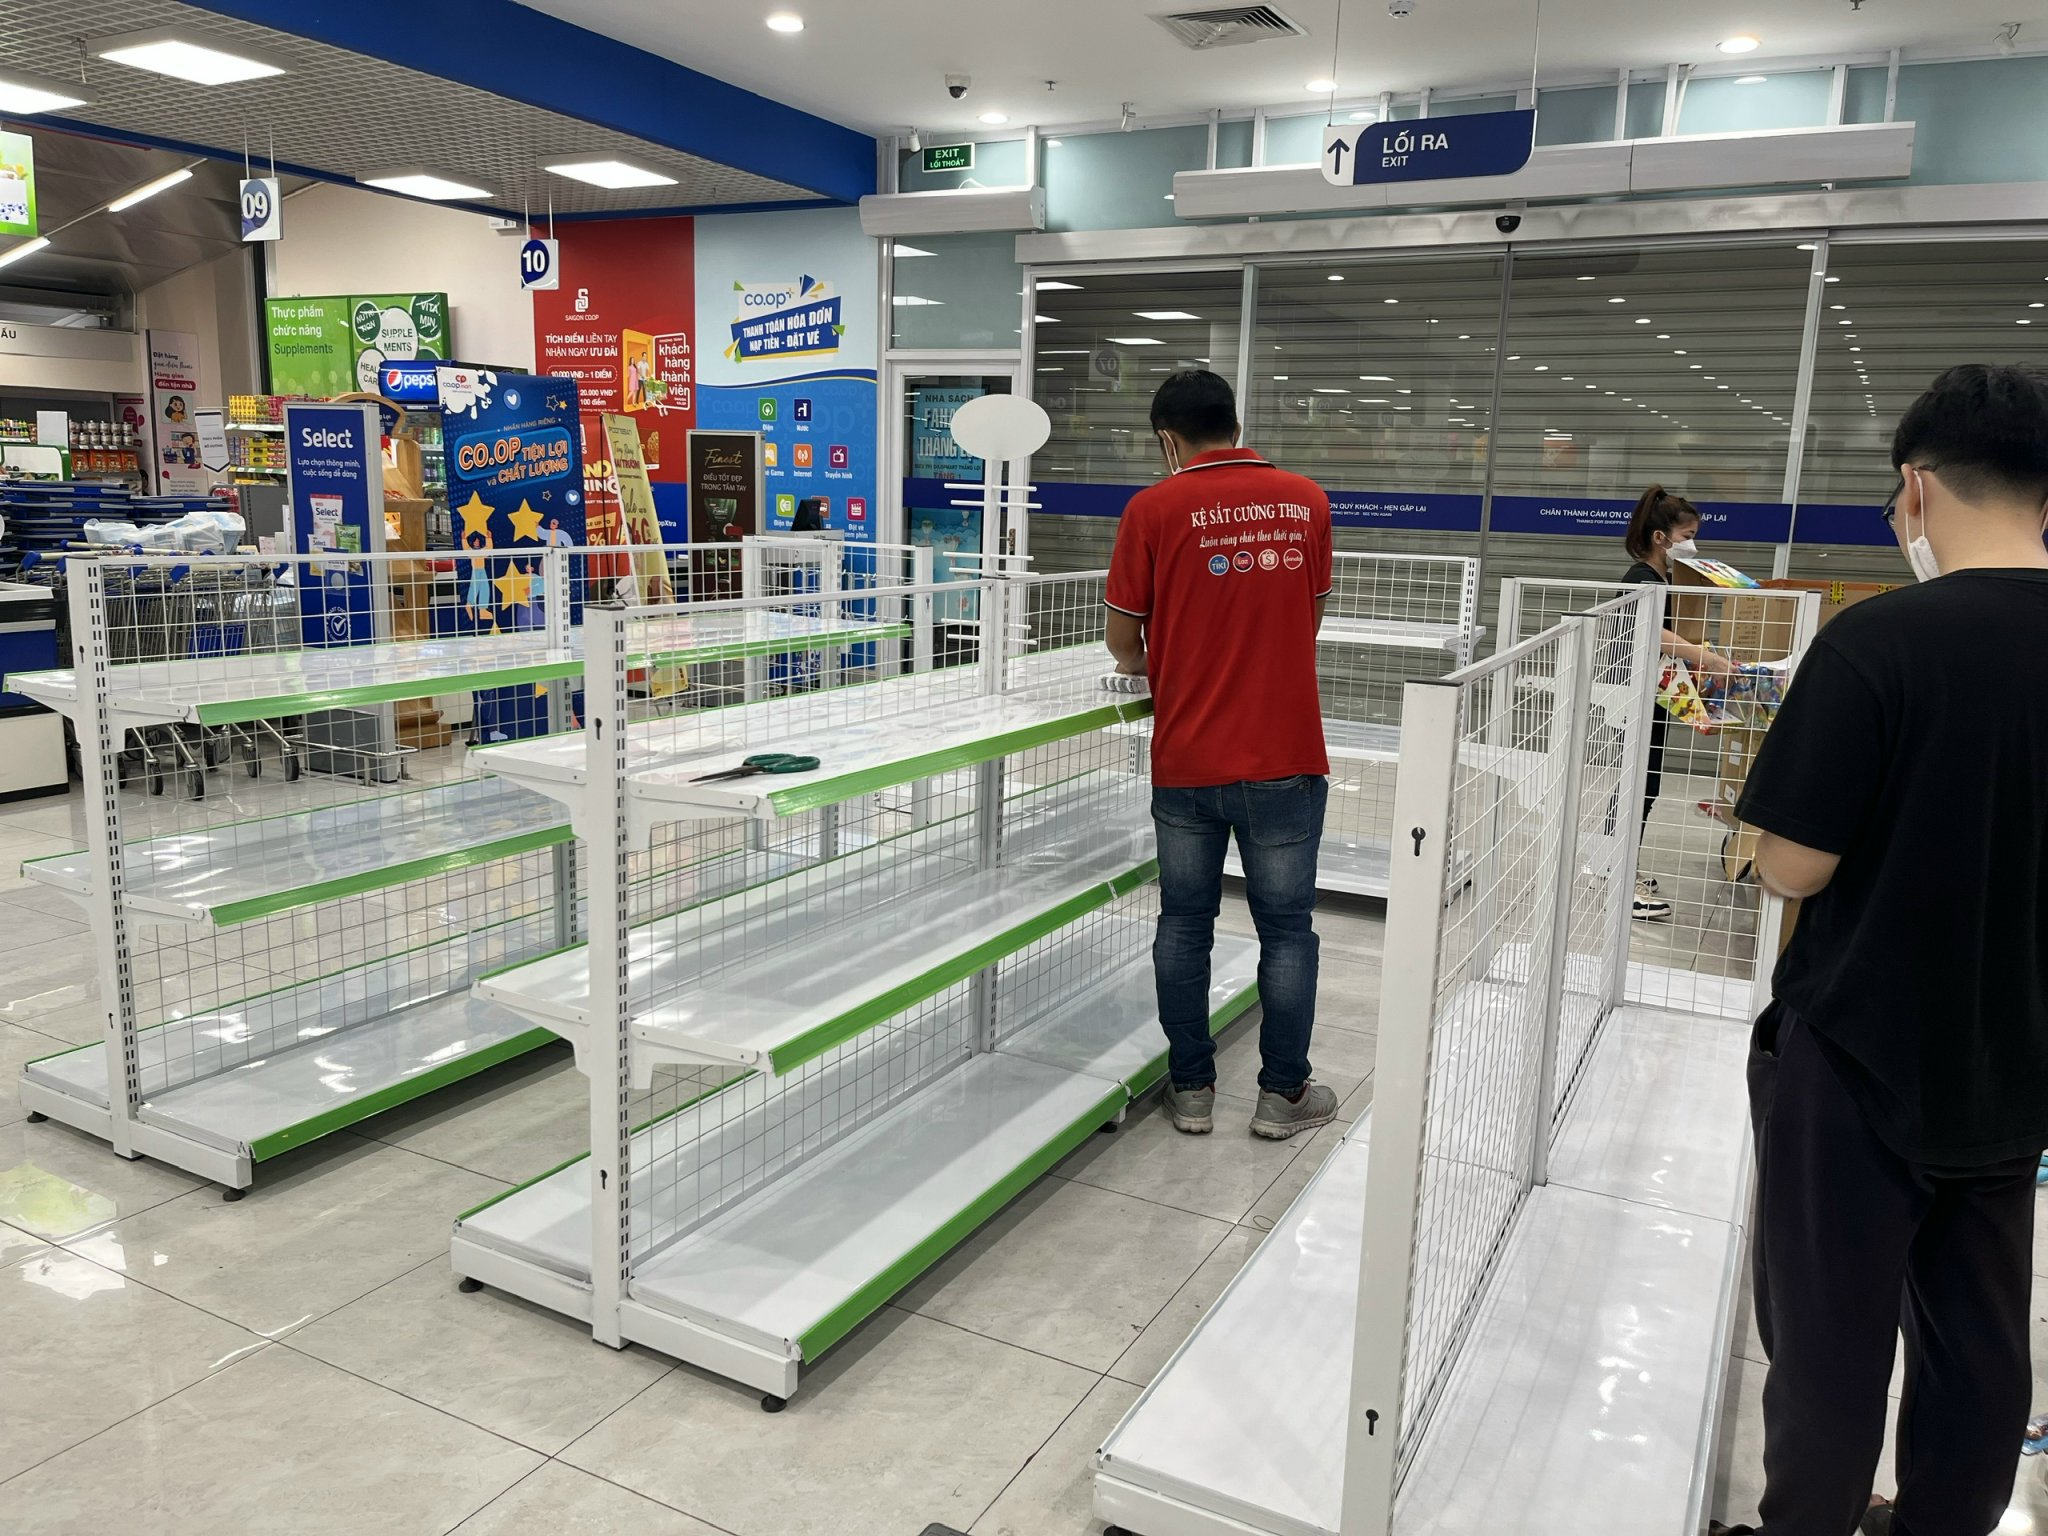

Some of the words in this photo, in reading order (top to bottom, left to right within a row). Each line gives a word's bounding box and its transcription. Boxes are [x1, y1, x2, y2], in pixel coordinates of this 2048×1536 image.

[1382, 129, 1415, 154] LỐI
[1421, 133, 1449, 151] RA
[935, 148, 960, 159] EXIT
[930, 158, 941, 168] LỐI
[942, 157, 965, 168] THOÁT
[1382, 155, 1409, 168] EXIT
[242, 191, 268, 219] 09
[522, 249, 546, 272] 10
[744, 292, 786, 308] co.op
[272, 306, 295, 321] Thực
[298, 304, 324, 320] phẩm
[743, 323, 764, 338] THANH
[765, 317, 785, 335] TOÁN
[787, 313, 806, 331] HÓA
[809, 307, 833, 326] ĐƠN
[273, 325, 297, 336] chức
[299, 326, 322, 338] năng
[381, 328, 413, 339] SUPPLE
[545, 333, 563, 343] TÍCH
[604, 335, 618, 343] TAY
[383, 342, 412, 352] MENTS
[749, 340, 763, 352] NẠP
[764, 335, 779, 350] TIỀN
[787, 333, 805, 349] ĐẶT
[274, 343, 333, 357] Supplements
[546, 346, 566, 358] NHẬN
[568, 347, 588, 357] NGAY
[590, 347, 602, 357] ƯU
[604, 345, 618, 357] ĐÃI
[659, 343, 690, 356] khách
[665, 357, 690, 370] hàng
[661, 371, 690, 383] thành
[669, 384, 690, 396] viên
[302, 428, 353, 448] Select
[459, 437, 520, 470] CO.OP
[704, 448, 742, 466] Finest
[297, 458, 309, 467] Lựa
[311, 458, 325, 467] chọn
[326, 459, 343, 468] thông
[303, 469, 317, 477] cuộc
[318, 469, 332, 478] sống
[316, 508, 338, 516] Select
[1339, 502, 1354, 510] QUÝ
[1354, 502, 1378, 510] KHÁCH
[1400, 504, 1414, 512] GẶP
[1563, 509, 1588, 517] THÀNH
[1190, 507, 1207, 530] KỆ
[1209, 501, 1232, 525] SẮT
[1233, 501, 1276, 523] CƯỜNG
[1277, 503, 1311, 523] THỊNH
[1714, 514, 1727, 523] LẠI
